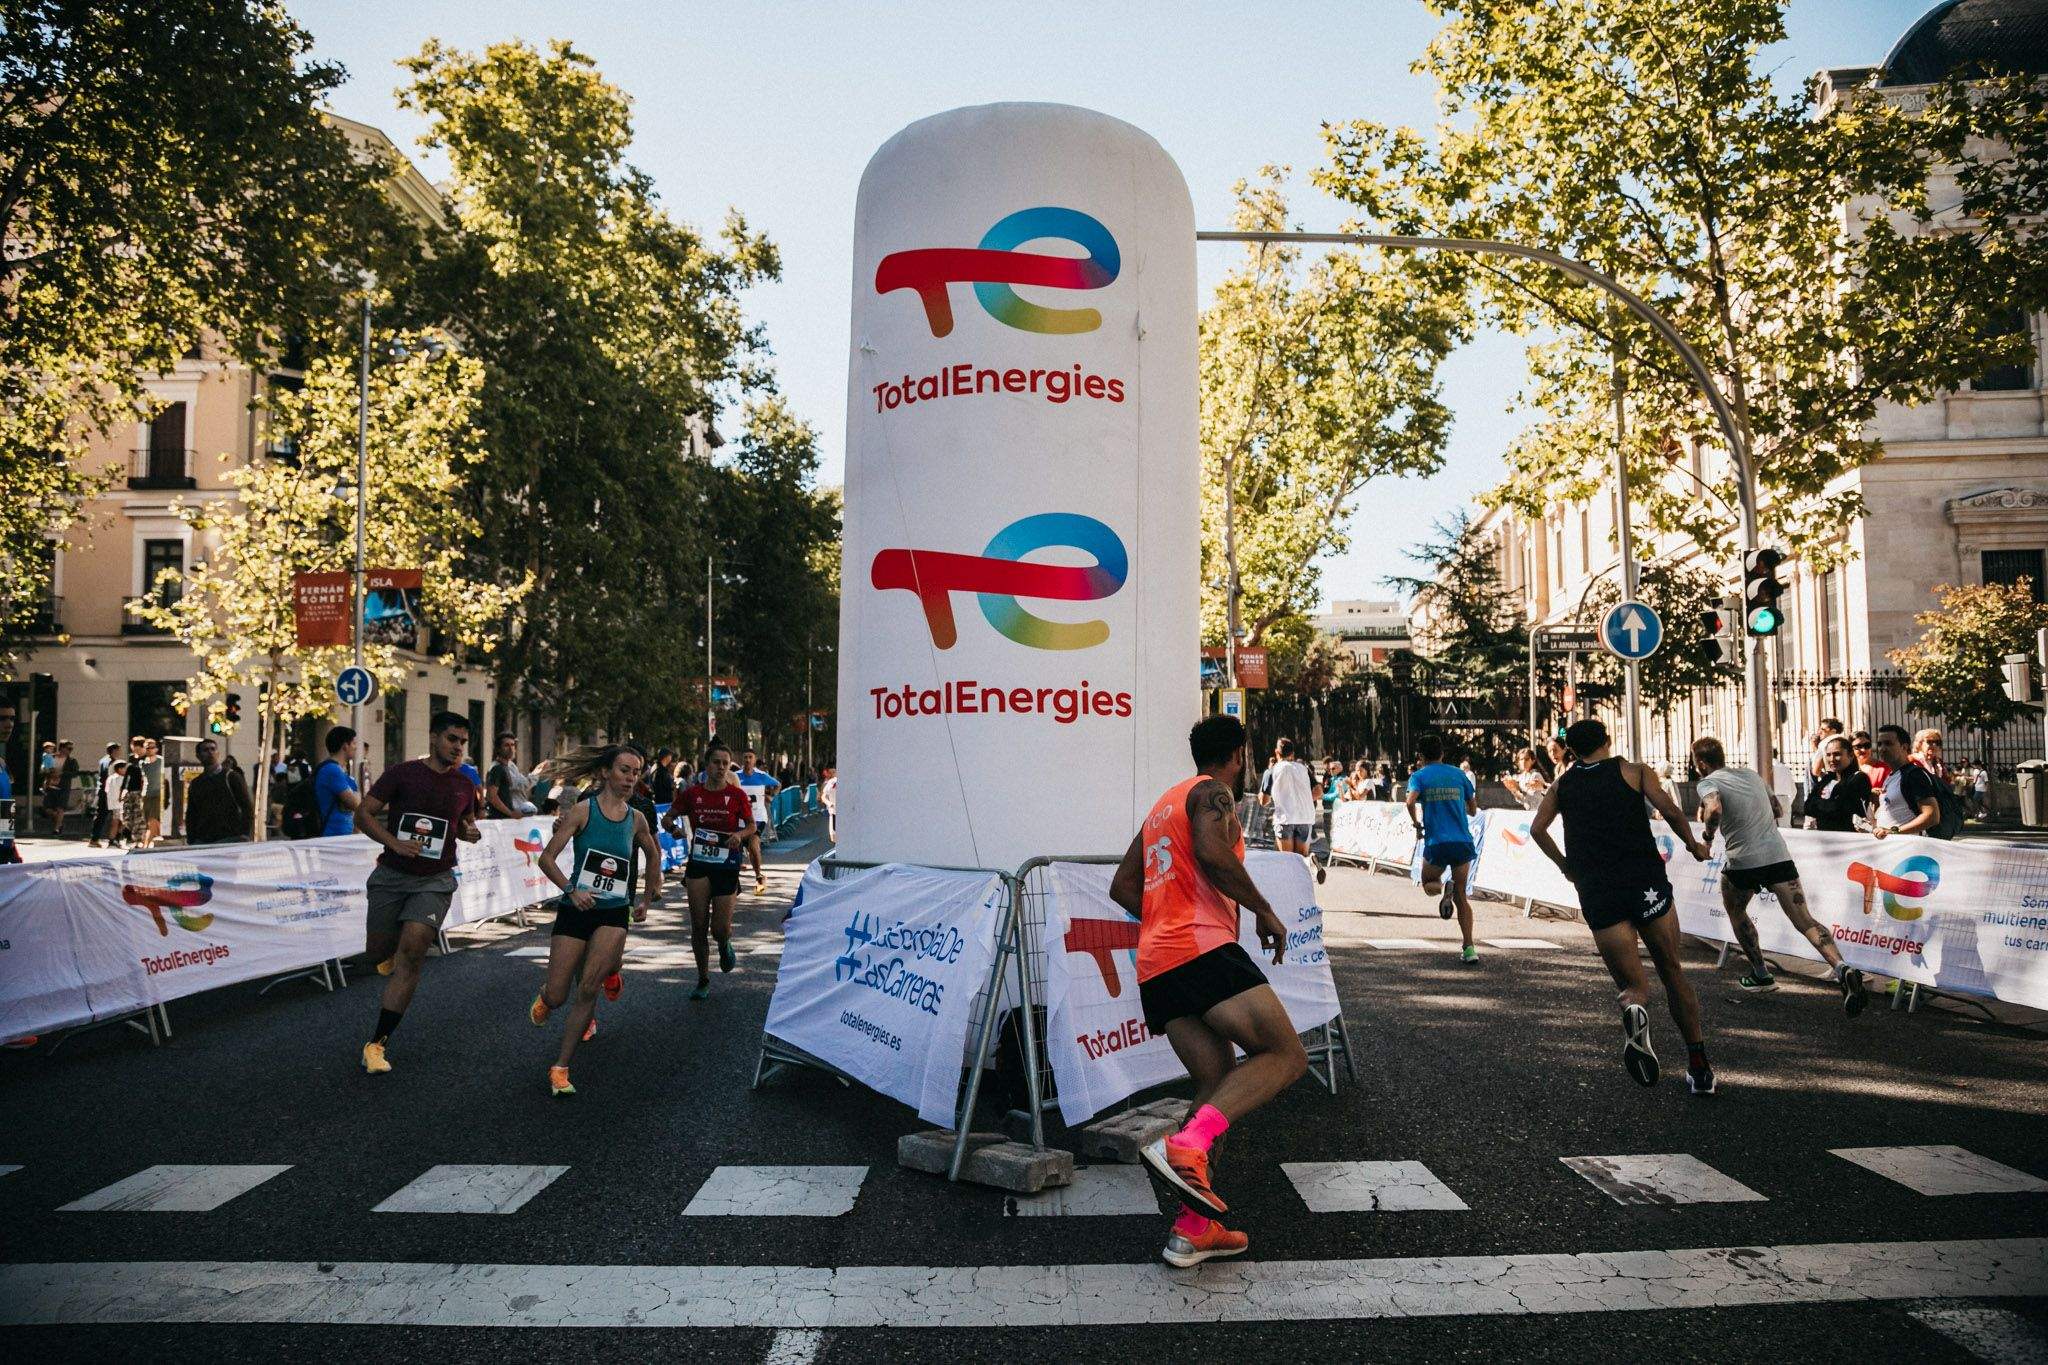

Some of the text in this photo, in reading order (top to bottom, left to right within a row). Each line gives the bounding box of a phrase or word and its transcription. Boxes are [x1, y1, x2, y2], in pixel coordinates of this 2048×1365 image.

[873, 364, 1125, 414] TotalEnergies
[371, 578, 393, 587] ISLA
[1550, 641, 1558, 649] LA
[1559, 641, 1580, 649] ARMADA
[870, 680, 1132, 724] TotalEnergies
[592, 874, 615, 892] 816
[1983, 910, 2048, 931] multiene
[1831, 924, 1924, 955] TotalEnergies
[2004, 935, 2023, 948] tus
[141, 943, 231, 976] TotalEnergies
[840, 1009, 902, 1052] totalenergies.es
[1076, 1018, 1154, 1061] TotalEn
